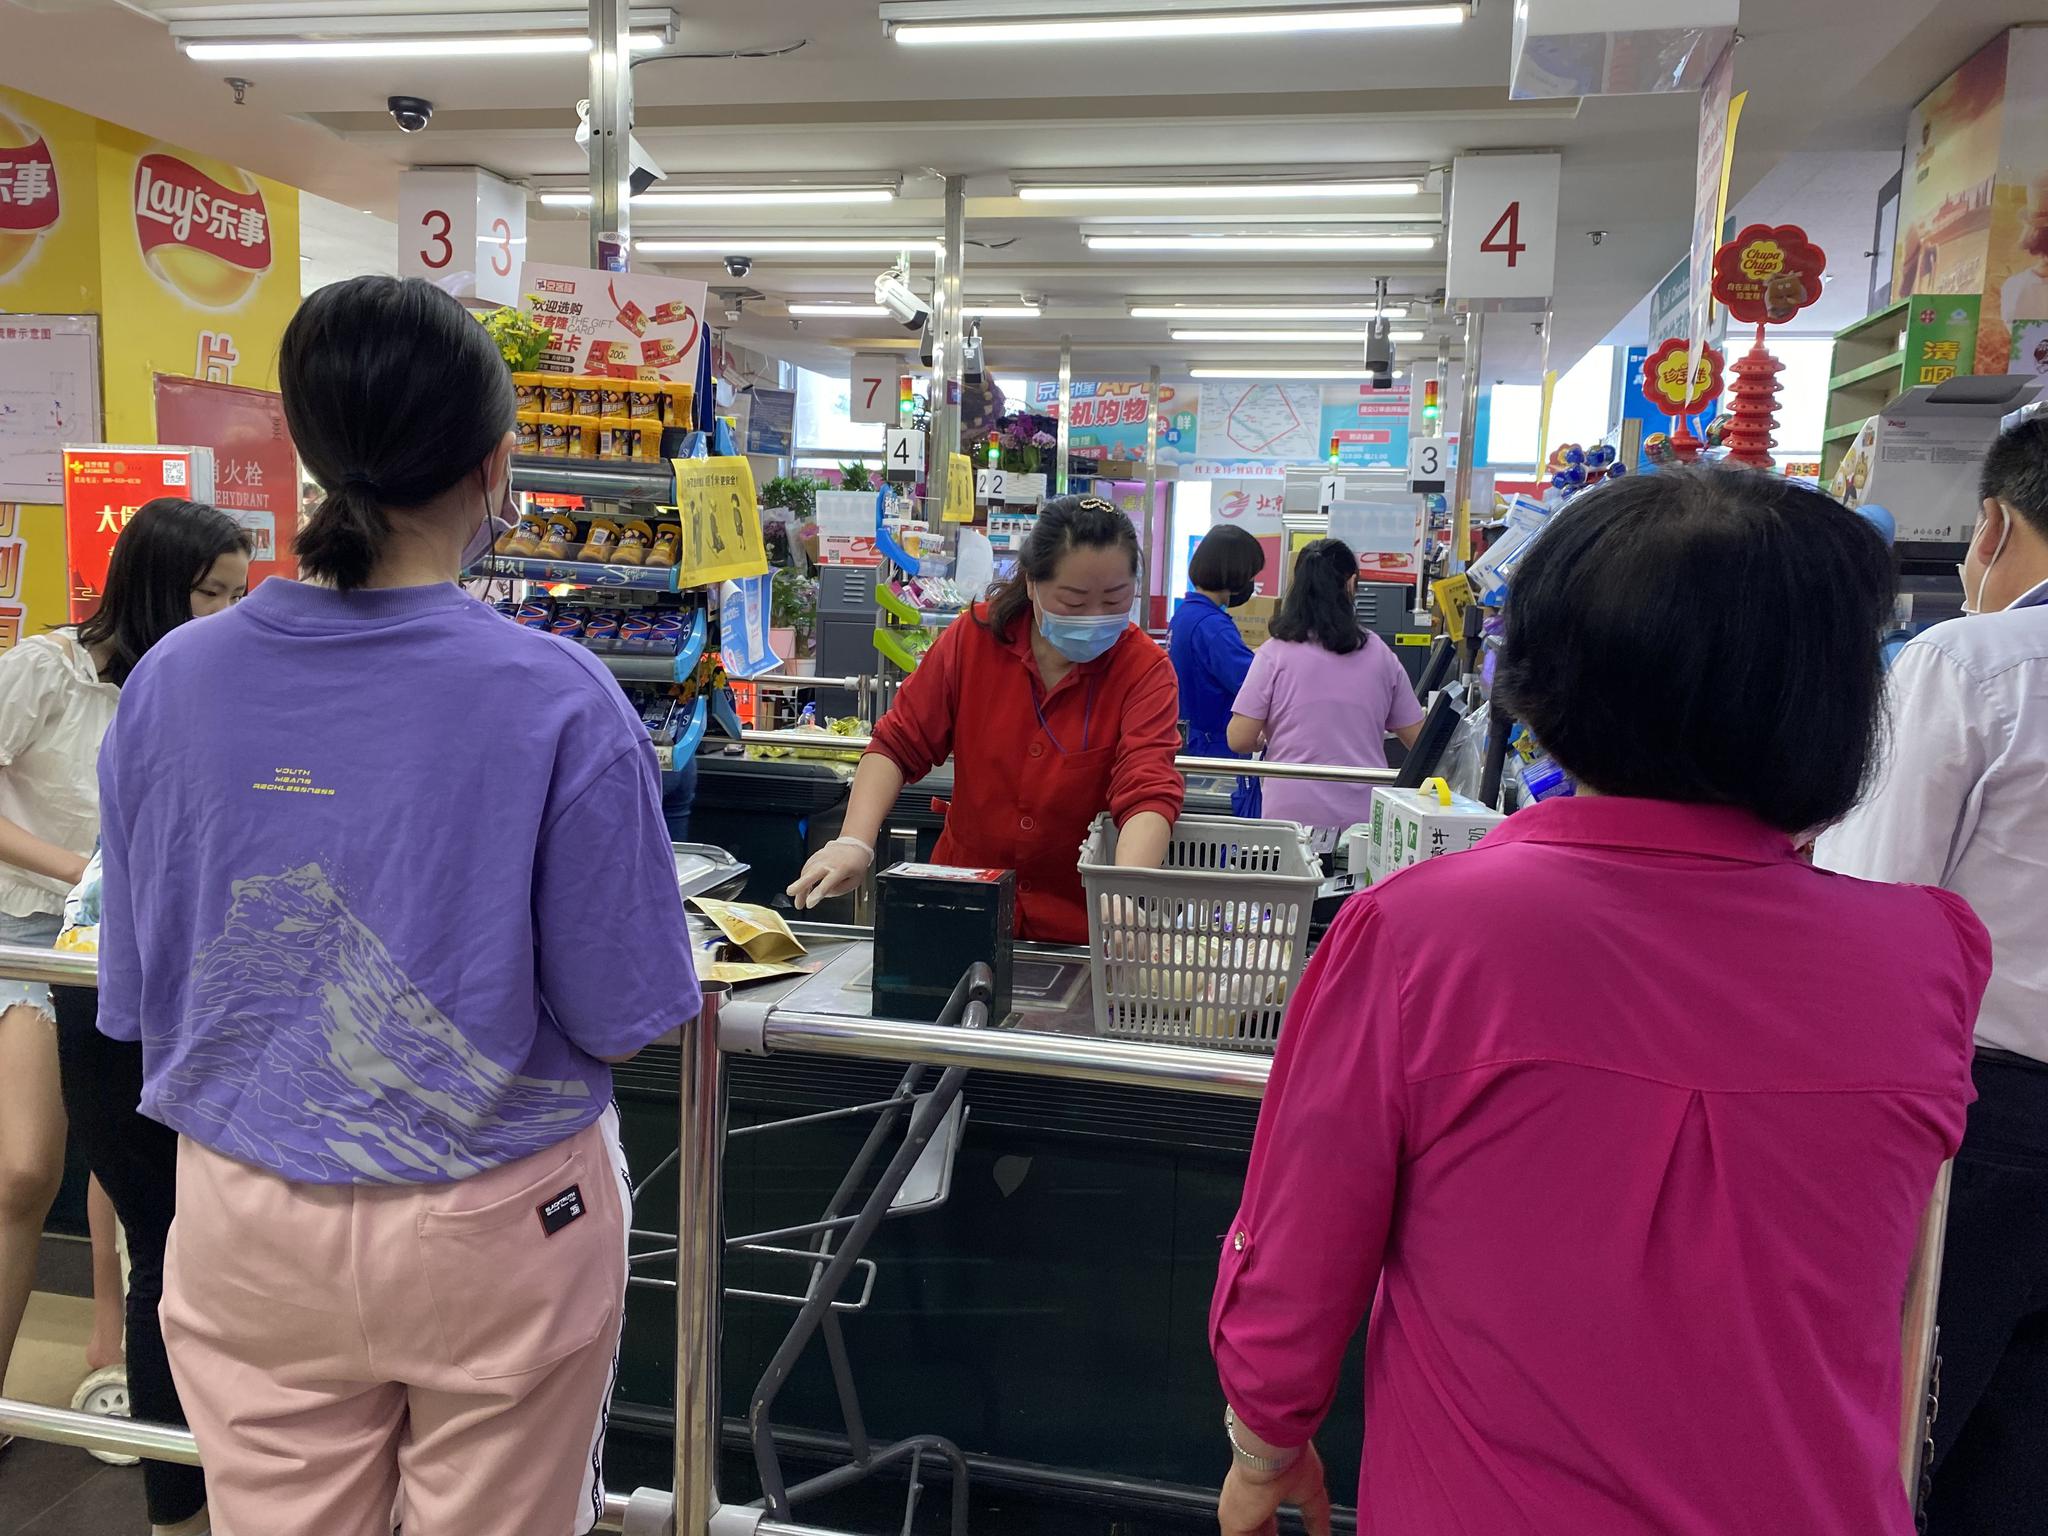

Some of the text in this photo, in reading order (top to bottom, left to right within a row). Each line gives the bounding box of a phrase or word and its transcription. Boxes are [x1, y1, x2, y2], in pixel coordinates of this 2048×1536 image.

[137, 166, 266, 248] Lay's 乐事
[420, 209, 453, 269] 3
[1480, 201, 1527, 268] 4
[490, 217, 512, 277] 3
[1746, 249, 1782, 261] Chupa
[1743, 260, 1778, 276] Chups
[532, 300, 583, 316] 欢迎选购
[862, 377, 882, 409] 7
[893, 437, 910, 465] 4
[1420, 446, 1439, 475] 3
[978, 474, 1004, 495] 2 2
[1327, 481, 1336, 501] 1
[275, 767, 311, 775] YOUTH
[275, 776, 312, 784] MEANS
